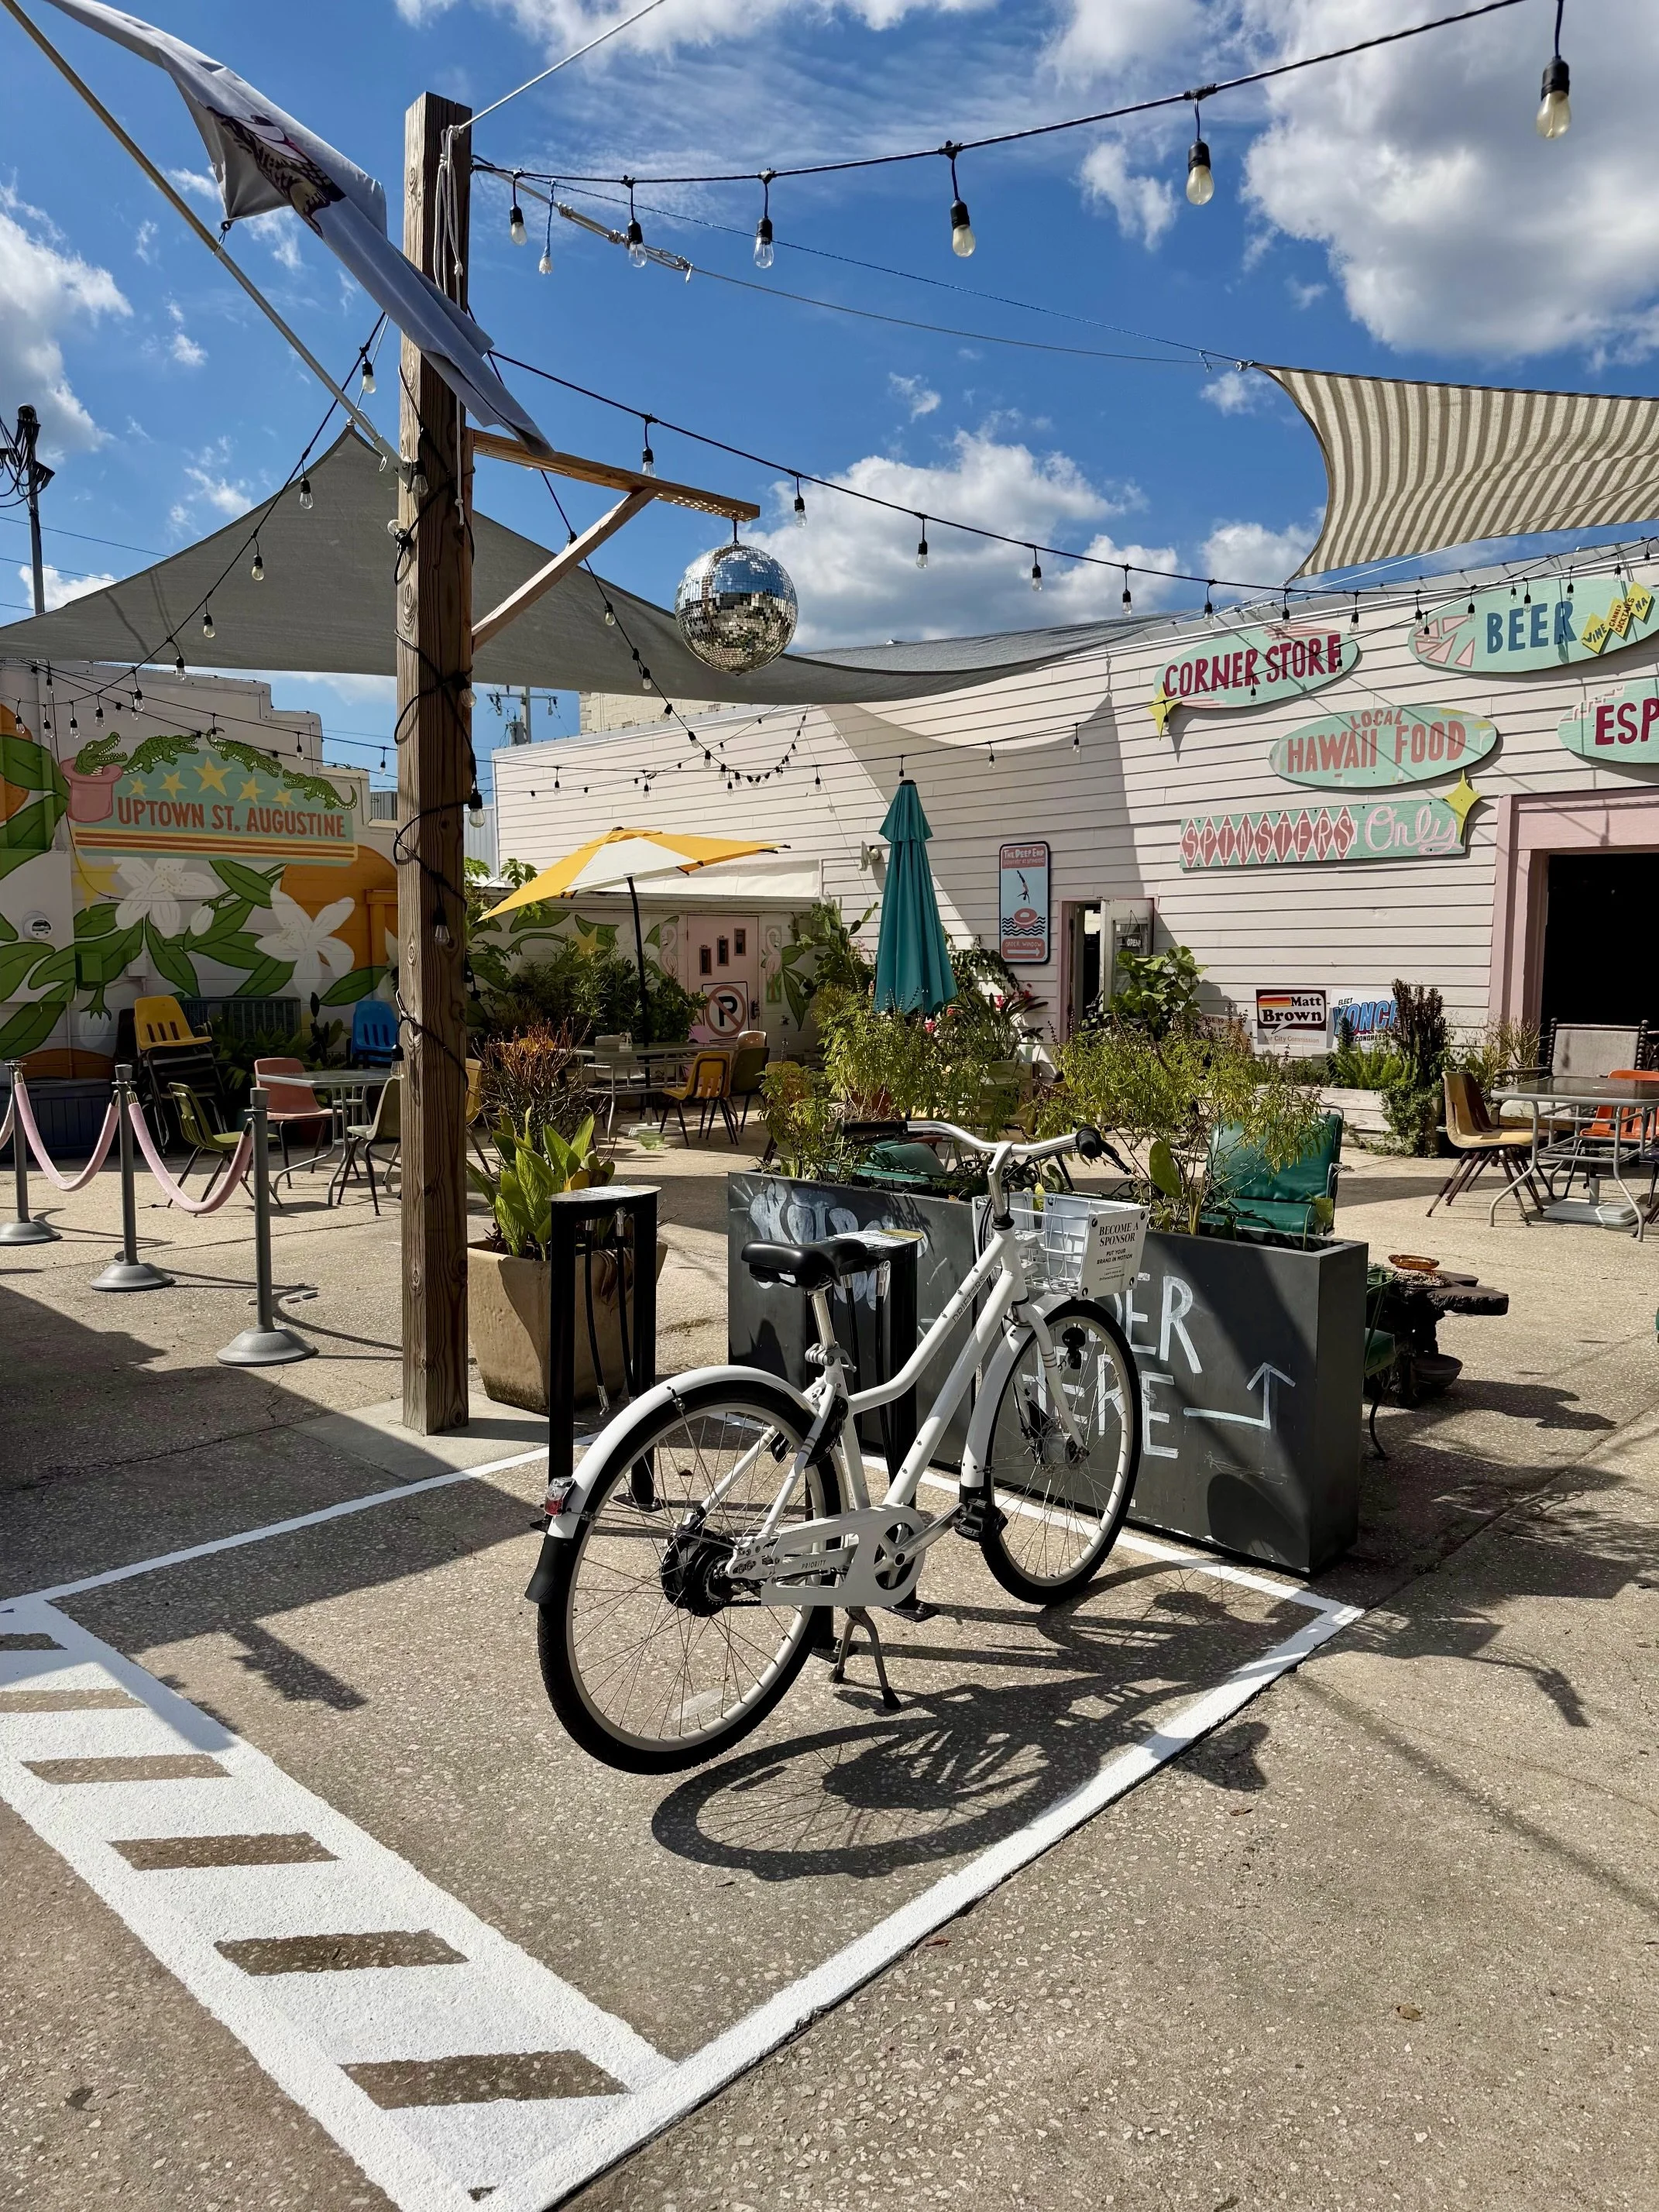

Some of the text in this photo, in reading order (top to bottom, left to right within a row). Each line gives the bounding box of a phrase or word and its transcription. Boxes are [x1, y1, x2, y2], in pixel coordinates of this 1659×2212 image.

[1609, 605, 1622, 627] CANNED
[1616, 597, 1635, 633] COCKTAILS
[1487, 600, 1577, 654] BEER
[1582, 623, 1607, 643] WINE
[1165, 634, 1341, 697] CORNER STORE
[1350, 708, 1403, 730] LOCAL
[1287, 720, 1466, 773] HAWAII FOOD
[117, 796, 347, 839] UPTOWN ST. AUGUSTINE
[1184, 805, 1464, 860] SPINSTERS Only
[1290, 996, 1322, 1007] Matt
[1262, 1009, 1323, 1022] Brown
[1099, 1221, 1139, 1235] BECOME A
[1099, 1232, 1135, 1247] SPONSOR
[953, 1276, 985, 1323] DRIFTERS
[801, 1560, 827, 1570] PRIORITY
